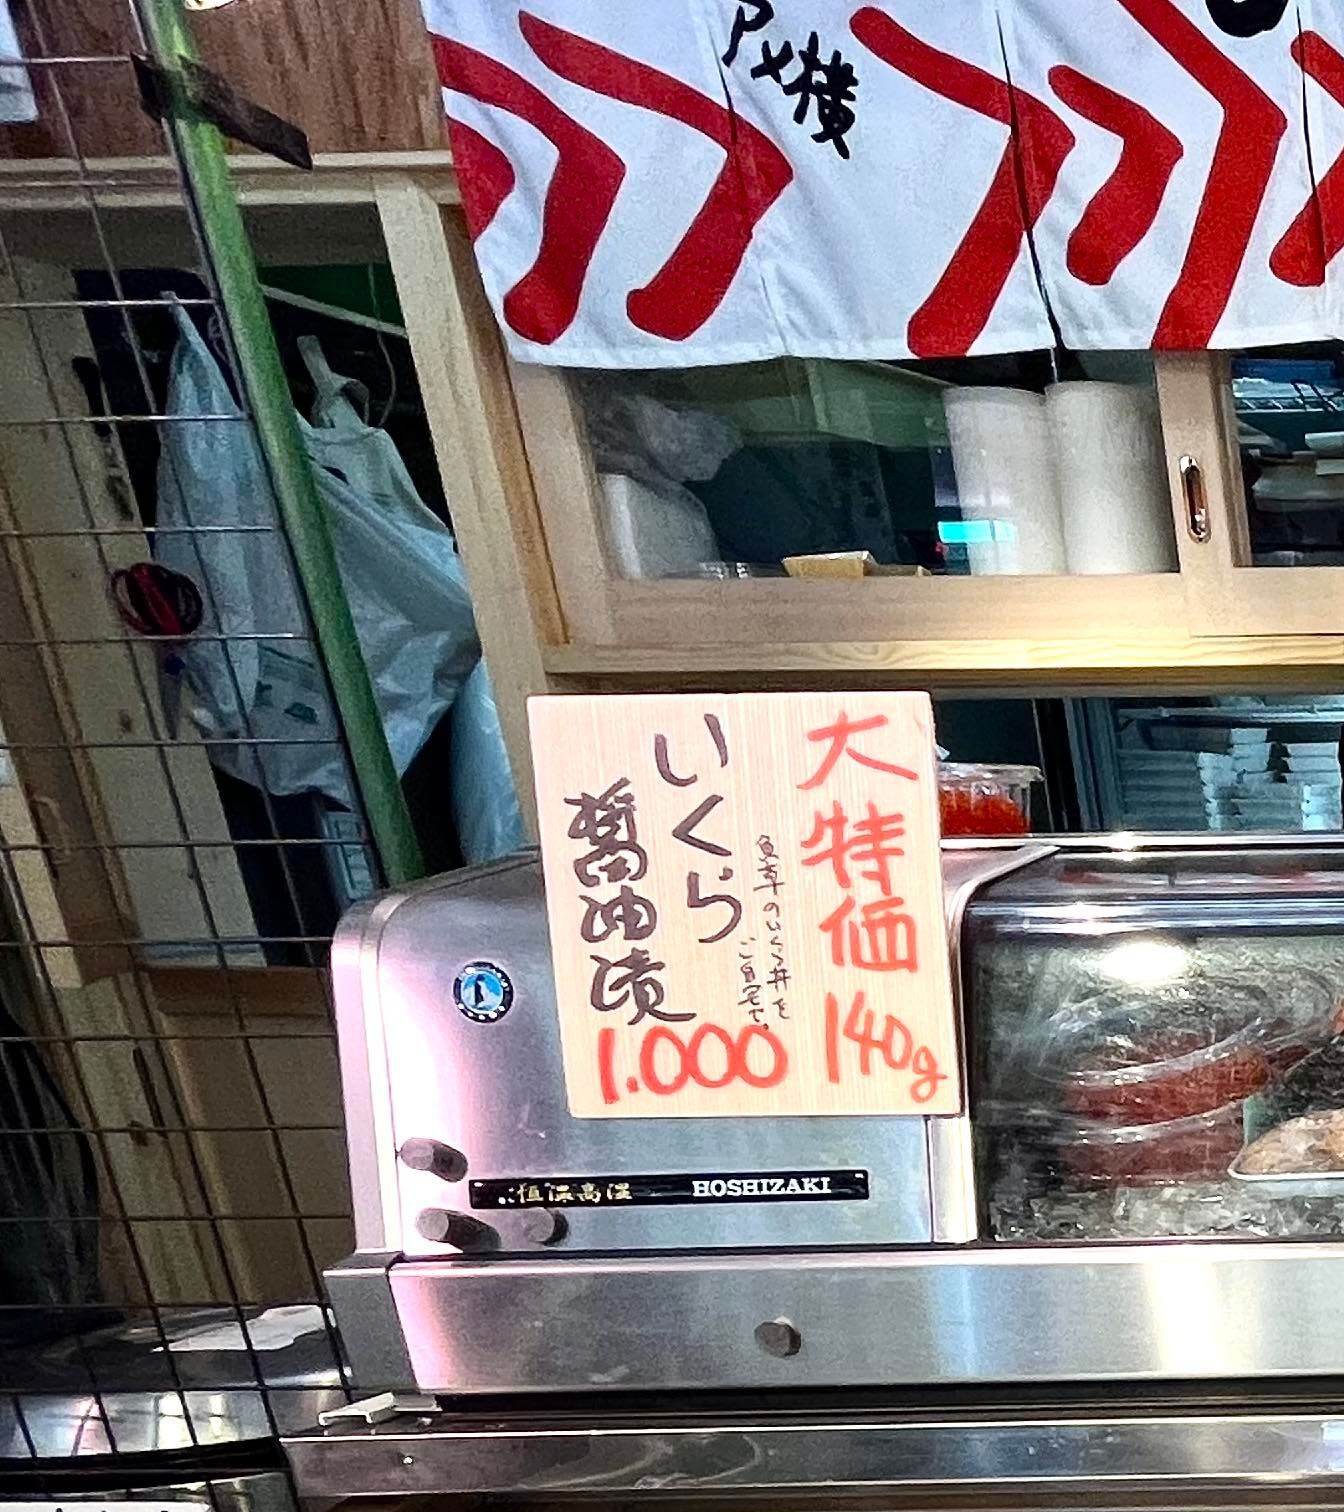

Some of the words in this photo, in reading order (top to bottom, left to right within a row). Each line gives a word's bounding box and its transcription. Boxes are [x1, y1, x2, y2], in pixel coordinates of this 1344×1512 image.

[653, 712, 743, 944] いくら
[796, 710, 922, 974] 大特価
[824, 990, 948, 1104] 140g
[691, 1176, 832, 1198] HOSHIZAKI
